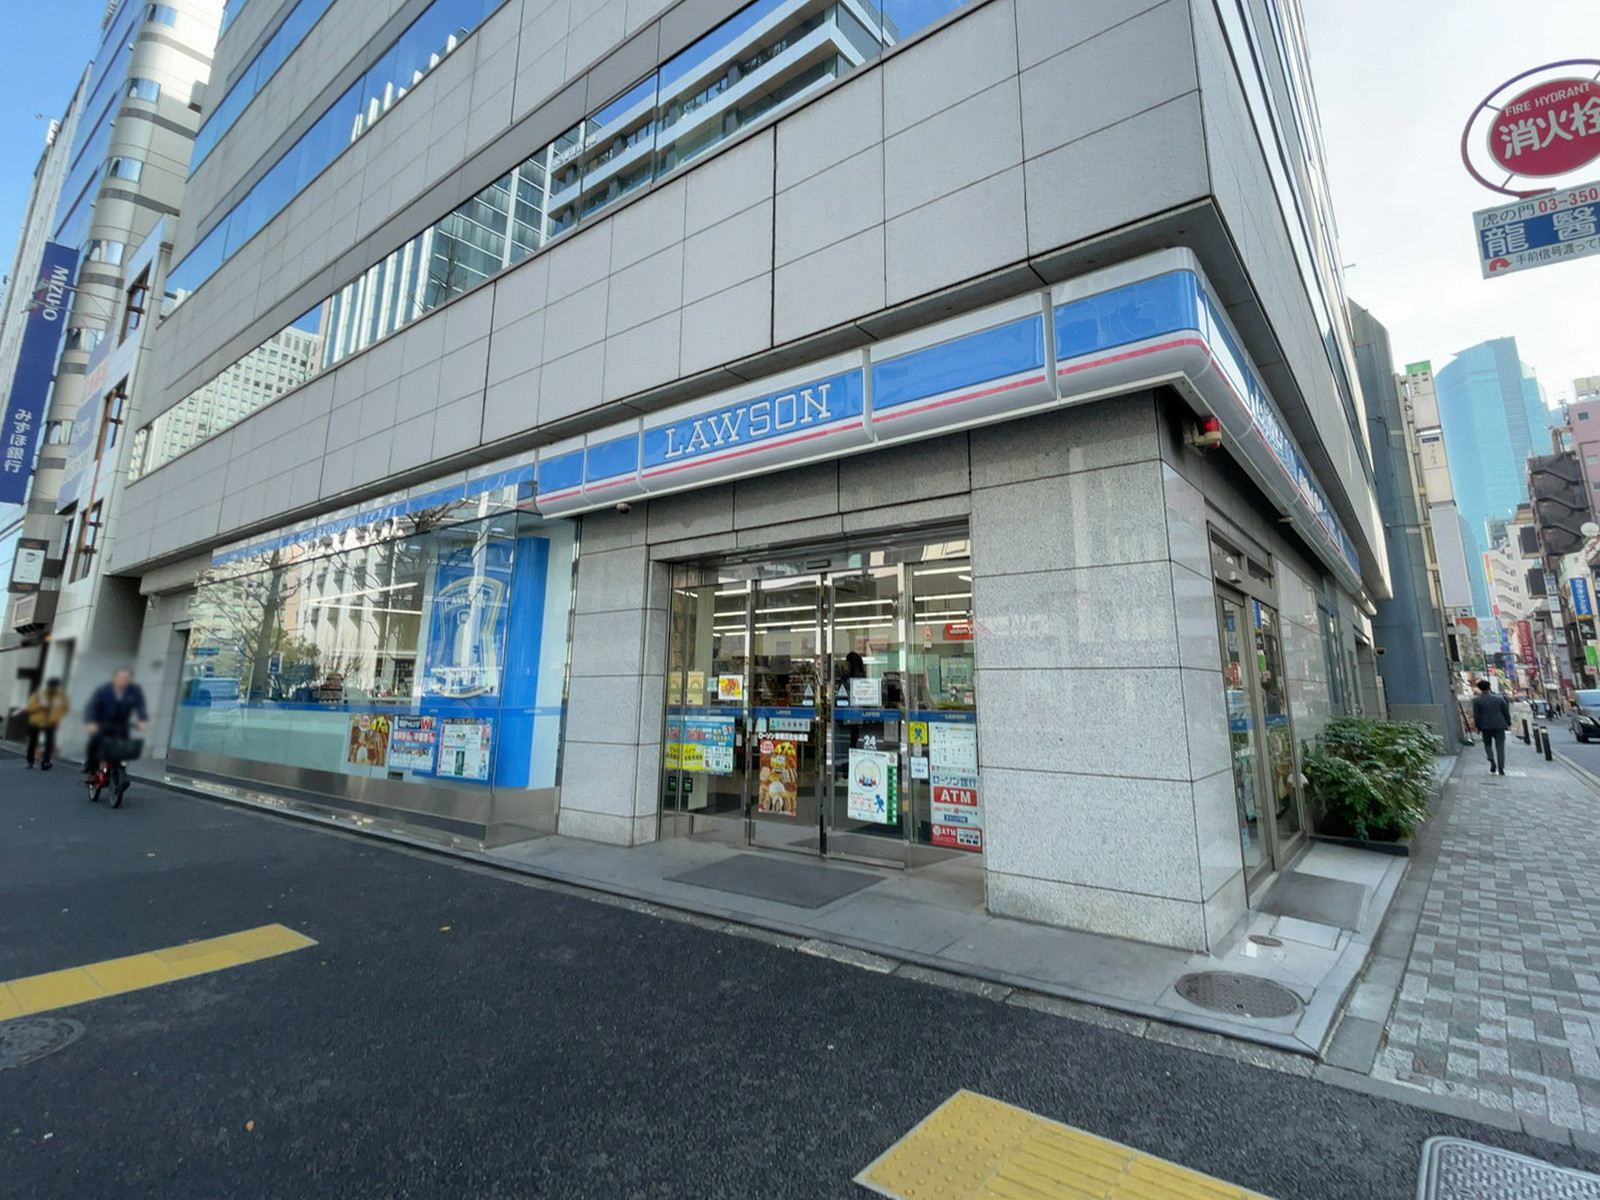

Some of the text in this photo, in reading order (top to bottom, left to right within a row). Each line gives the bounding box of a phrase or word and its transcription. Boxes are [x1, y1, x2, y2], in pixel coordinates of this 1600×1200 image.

[1505, 82, 1589, 117] FIRE HYDRANT
[1499, 96, 1600, 159] 消火栓
[1482, 188, 1599, 228] 虎の門 03-350
[1516, 236, 1600, 265] 手前信号渡って
[43, 264, 69, 321] MIZUHO
[4, 408, 32, 474] みずほ銀行
[664, 383, 831, 459] LAWSON
[940, 788, 971, 804] ATM
[941, 828, 957, 837] ATM
